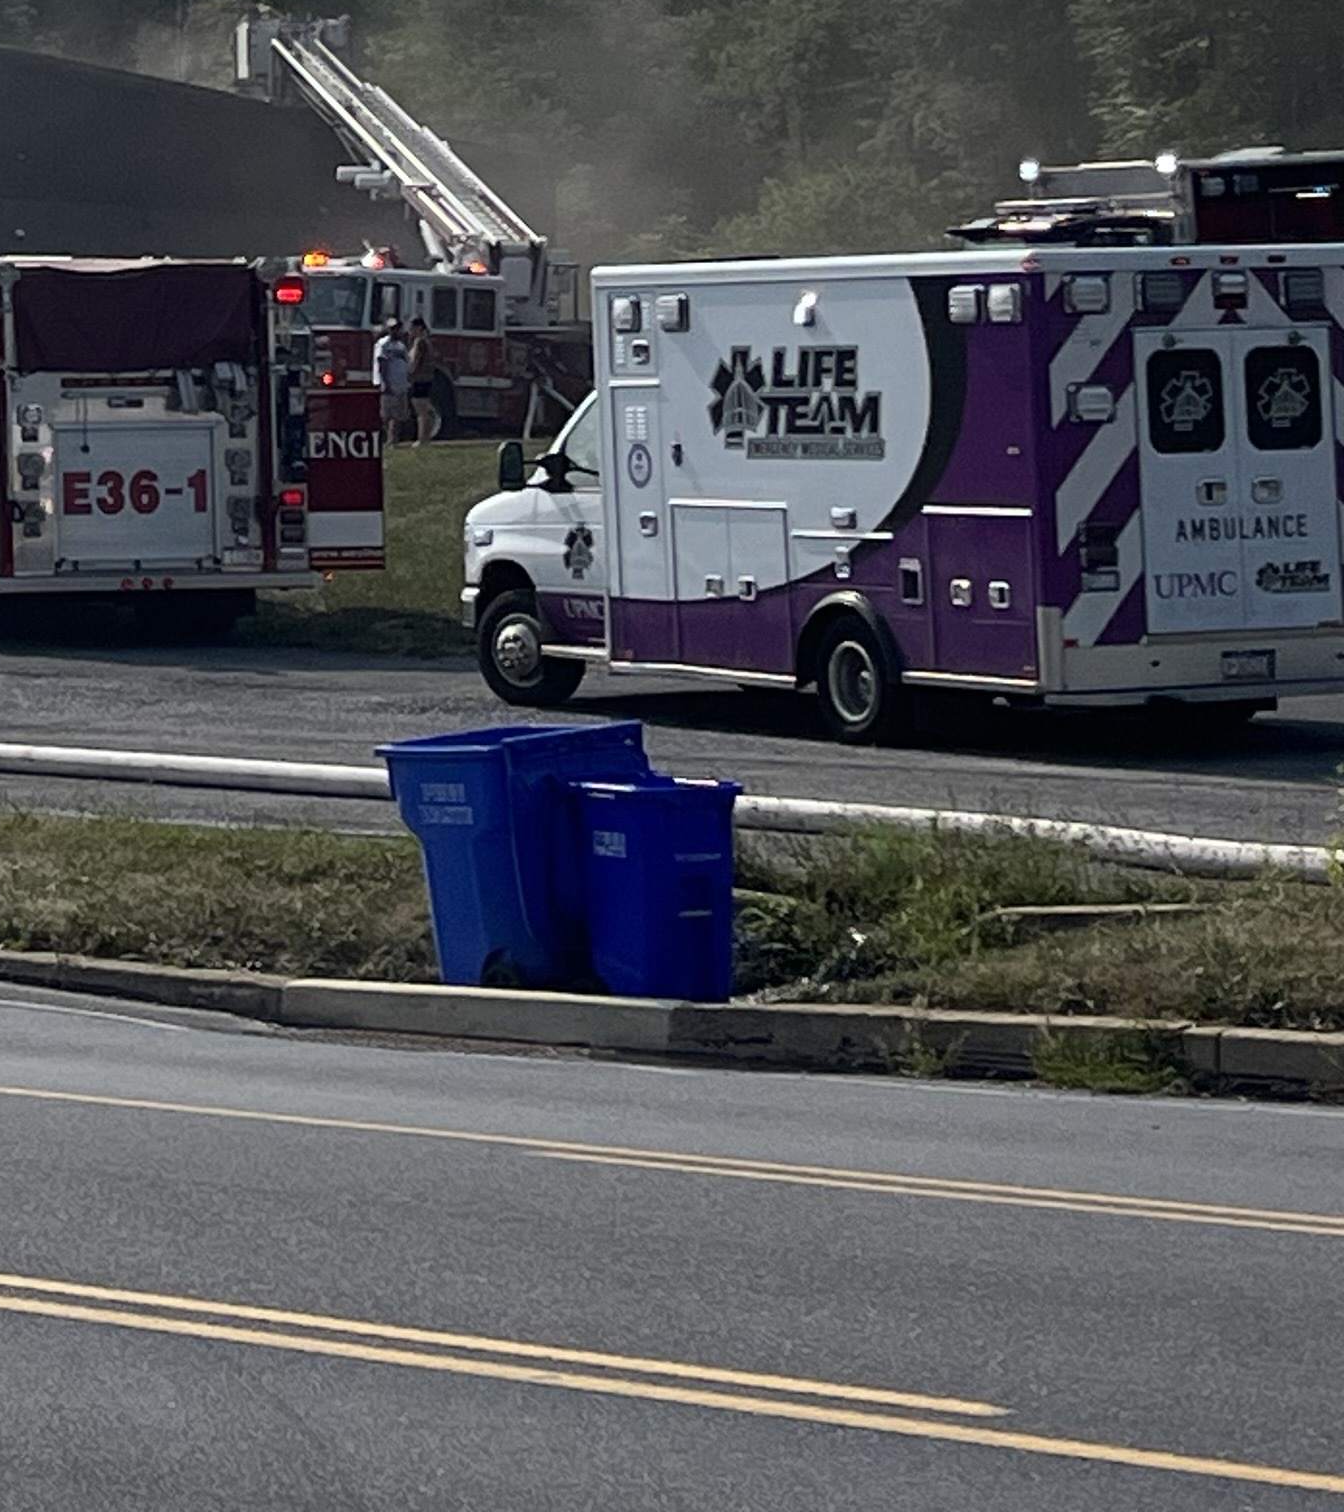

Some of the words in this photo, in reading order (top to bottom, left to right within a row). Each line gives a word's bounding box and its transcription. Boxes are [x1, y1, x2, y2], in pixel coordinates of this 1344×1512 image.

[770, 346, 859, 390] LIFE
[759, 392, 882, 437] TEAM
[307, 430, 381, 459] ENGI
[63, 468, 207, 515] E36-1
[1175, 513, 1309, 543] AMBULANCE
[1153, 571, 1238, 599] UPMC
